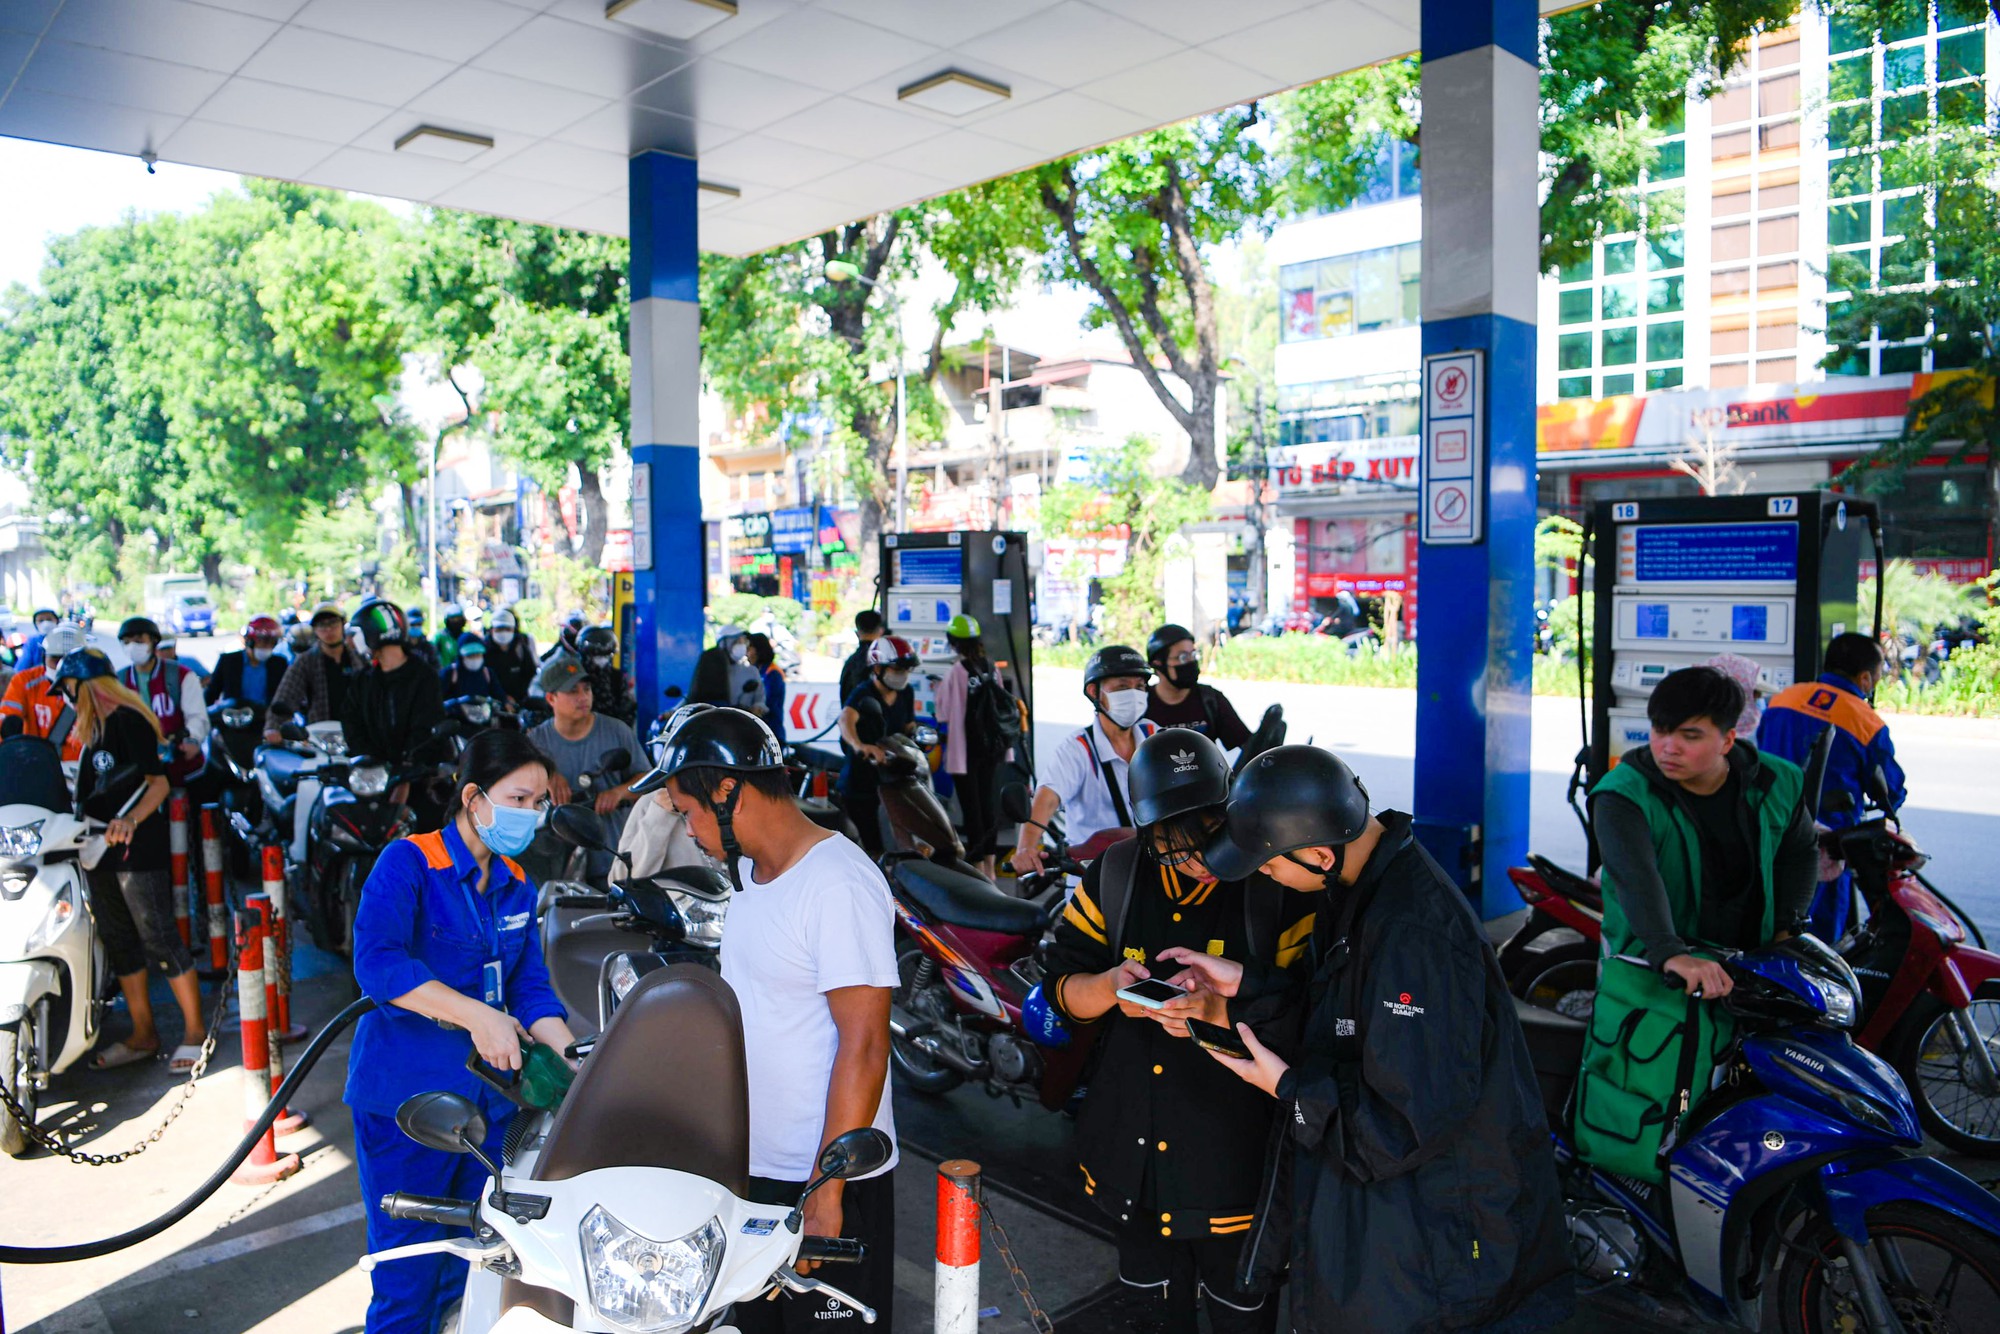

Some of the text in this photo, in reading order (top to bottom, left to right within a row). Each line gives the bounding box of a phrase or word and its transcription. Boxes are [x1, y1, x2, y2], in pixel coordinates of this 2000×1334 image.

[1617, 506, 1634, 518] 18
[1773, 499, 1793, 513] 17
[1626, 731, 1649, 741] VISA
[1173, 764, 1199, 773] adidas
[1852, 966, 1890, 979] HONDA
[1383, 1000, 1424, 1014] THE NORTH FACE
[1392, 1008, 1415, 1017] SUMMIT
[1784, 1047, 1825, 1073] YAMAHA
[814, 1310, 853, 1320] ATISTINO
